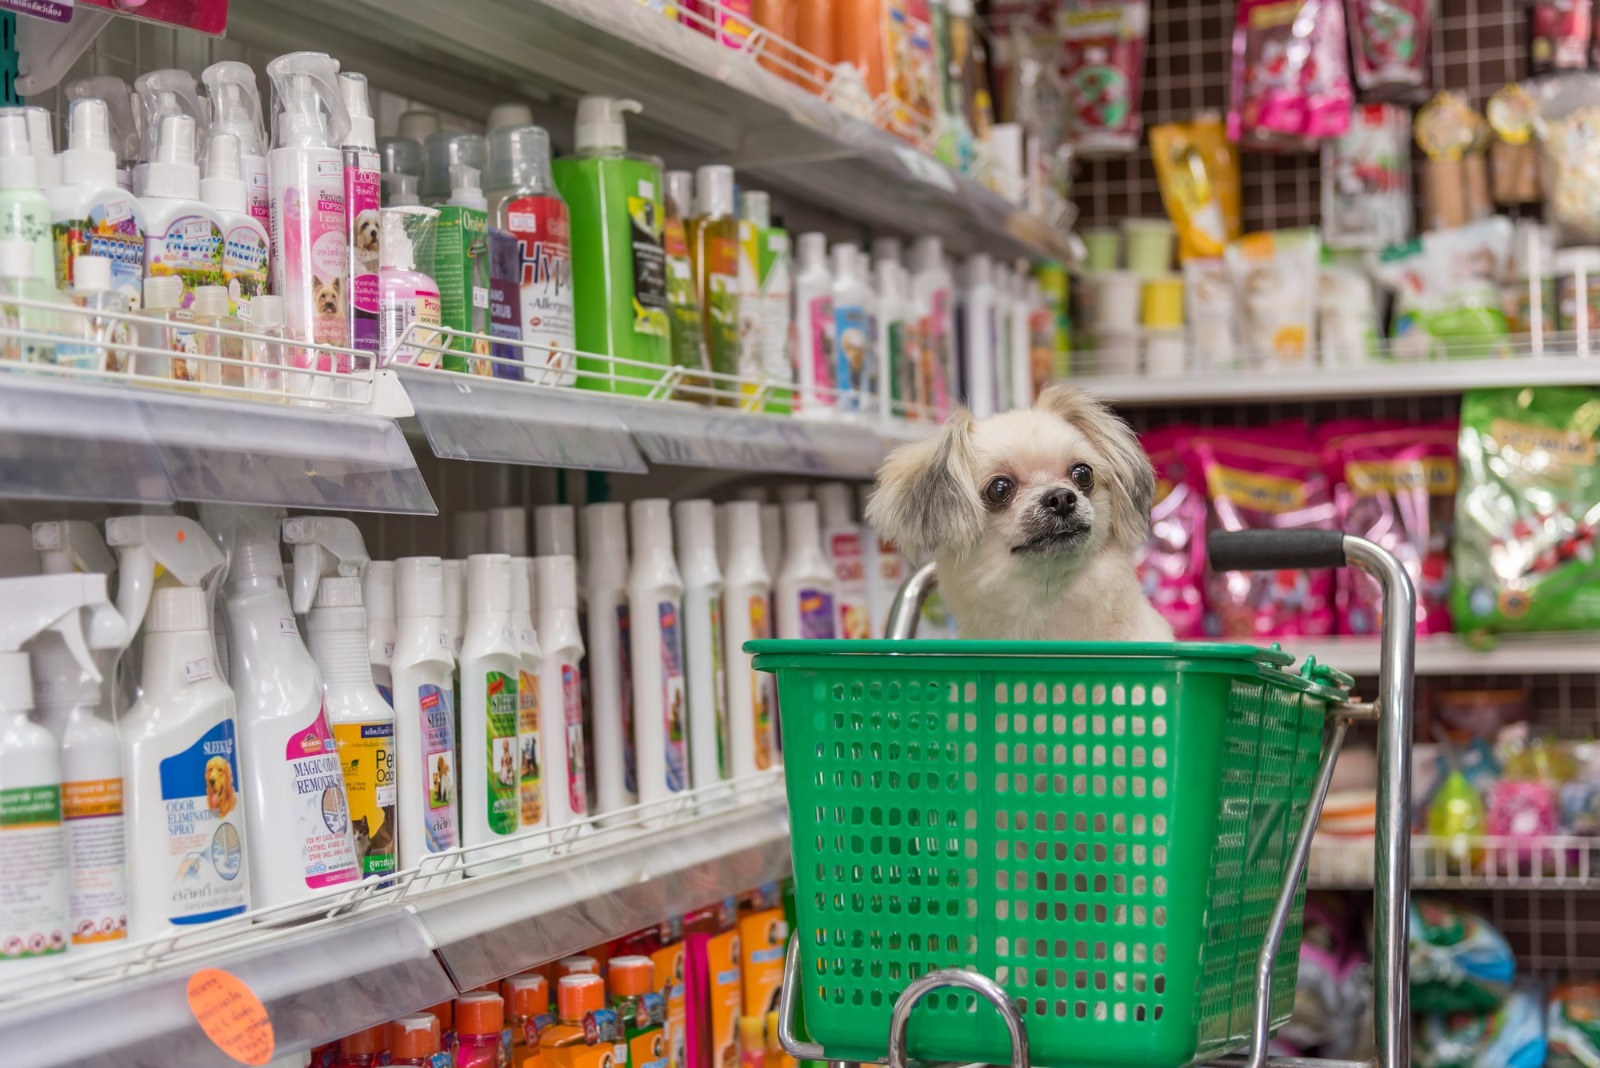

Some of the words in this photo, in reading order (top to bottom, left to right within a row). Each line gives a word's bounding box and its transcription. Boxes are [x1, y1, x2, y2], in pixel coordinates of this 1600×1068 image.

[293, 759, 322, 778] MAGIC
[166, 800, 194, 813] ODOR
[168, 823, 196, 837] SPRAY
